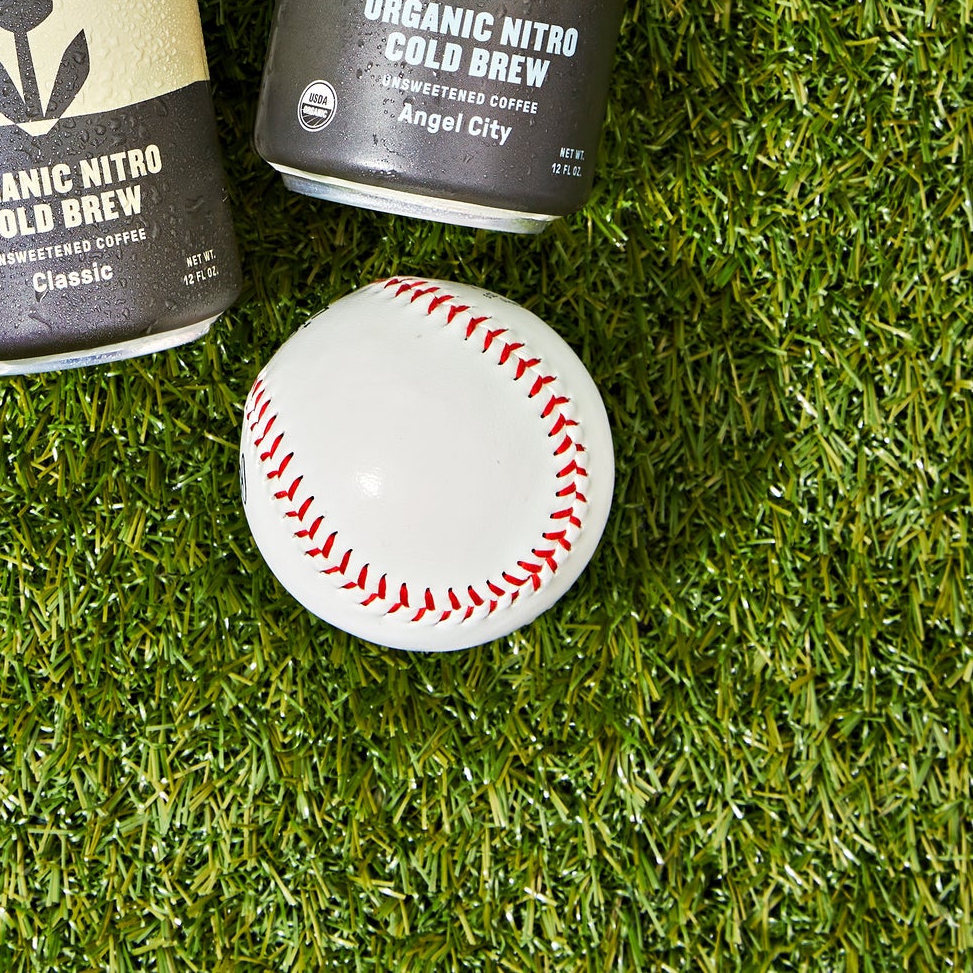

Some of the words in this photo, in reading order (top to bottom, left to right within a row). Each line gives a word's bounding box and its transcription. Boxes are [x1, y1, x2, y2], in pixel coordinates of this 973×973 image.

[500, 16, 579, 57] NITRO
[384, 31, 463, 73] COLD
[468, 47, 550, 88] BREW
[308, 92, 328, 106] USDA
[382, 75, 486, 105] UNSWEETENED
[489, 95, 539, 114] COFFEE
[398, 102, 463, 134] Angel
[468, 115, 513, 146] City
[80, 144, 162, 189] NITRO
[551, 162, 561, 174] 12
[562, 164, 571, 176] FL
[572, 166, 582, 177] OZ.
[559, 147, 574, 159] NET
[575, 149, 585, 161] WT.
[61, 184, 142, 229] BREW
[96, 227, 147, 250] COFFEE
[186, 253, 202, 268] NET
[203, 249, 217, 262] WT.
[32, 262, 114, 293] Classic
[183, 273, 195, 286] 12
[196, 270, 206, 282] FL
[207, 265, 220, 278] OZ.
